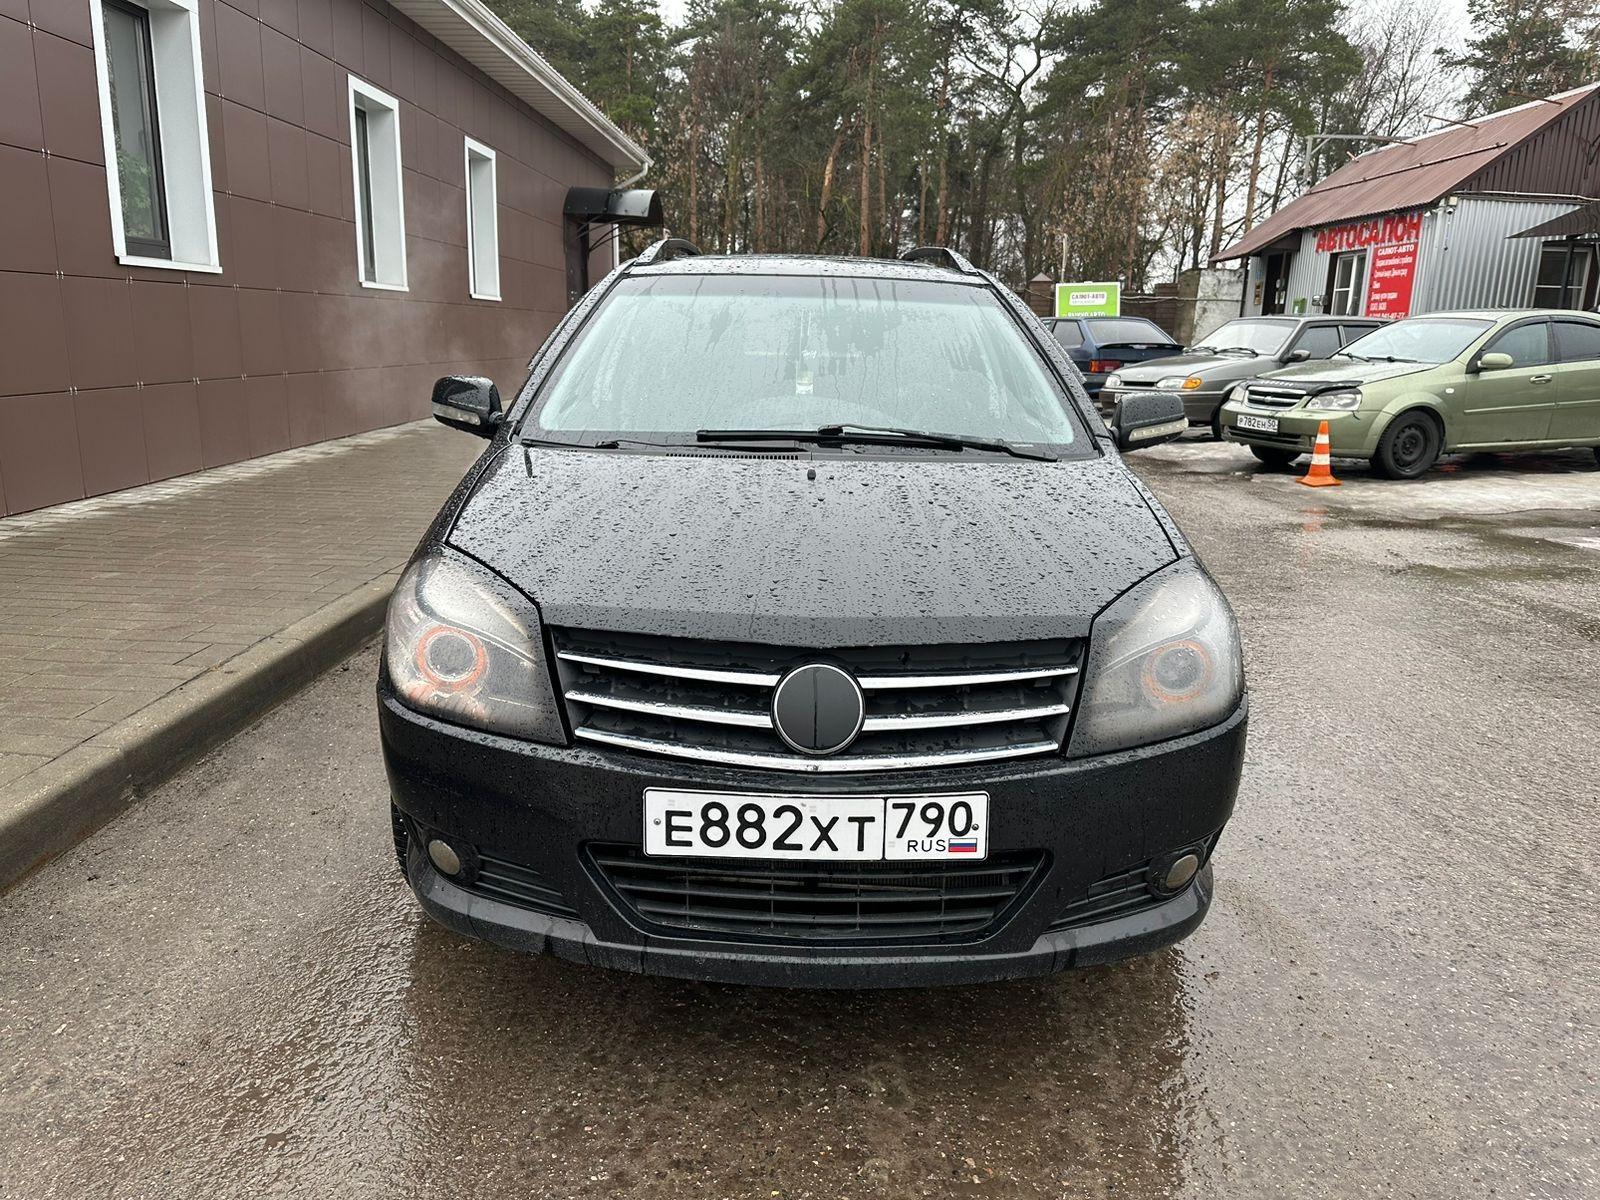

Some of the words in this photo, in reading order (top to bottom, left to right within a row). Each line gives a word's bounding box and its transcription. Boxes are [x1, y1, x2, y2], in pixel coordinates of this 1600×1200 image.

[1316, 211, 1424, 254] АВТОСАЛОН
[665, 801, 876, 852] Е882ХТ
[892, 801, 974, 838] 790
[907, 839, 946, 852] RUS
